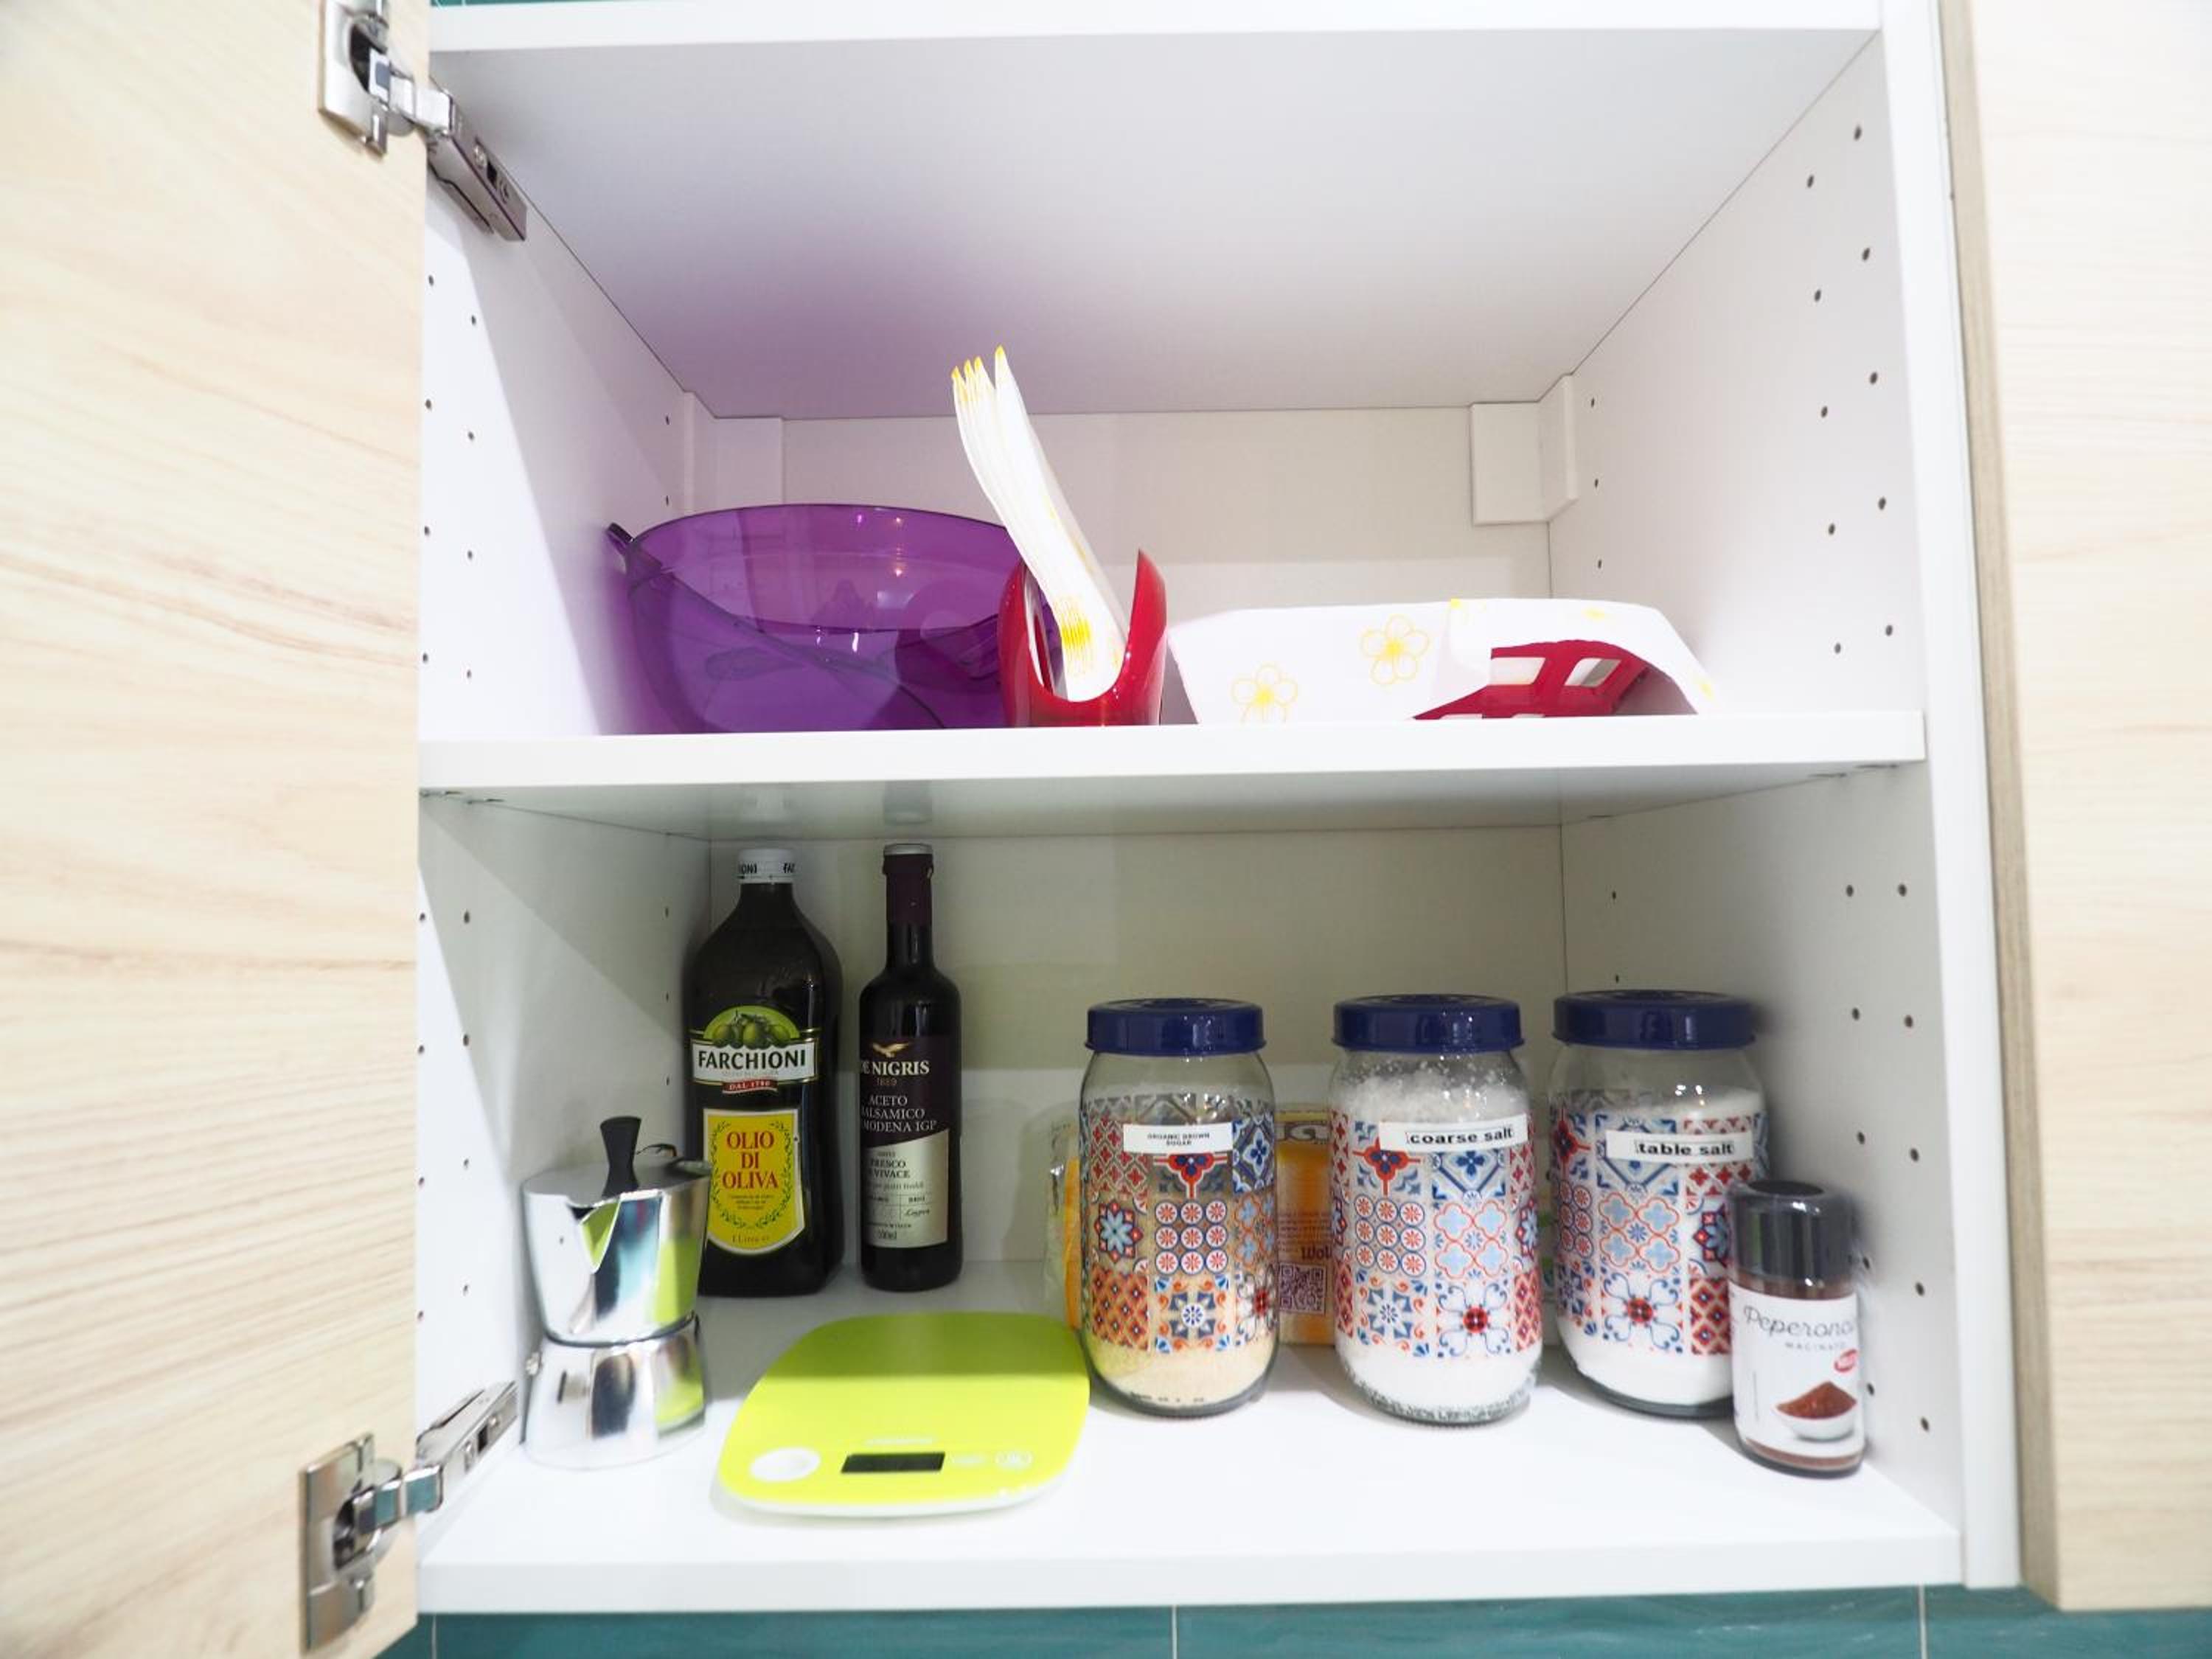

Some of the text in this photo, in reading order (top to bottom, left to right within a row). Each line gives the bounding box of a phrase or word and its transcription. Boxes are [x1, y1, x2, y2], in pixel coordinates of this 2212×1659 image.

[698, 1049, 806, 1070] FARCHIONI
[872, 1060, 930, 1076] NIGRIS
[869, 1094, 908, 1107] ACETO
[916, 1119, 937, 1131] IGP
[727, 1131, 774, 1150] OLIO
[1410, 1125, 1513, 1144] coarse salt
[1639, 1142, 1733, 1155] table salt
[741, 1152, 759, 1169] DI
[722, 1171, 779, 1189] OLIVA
